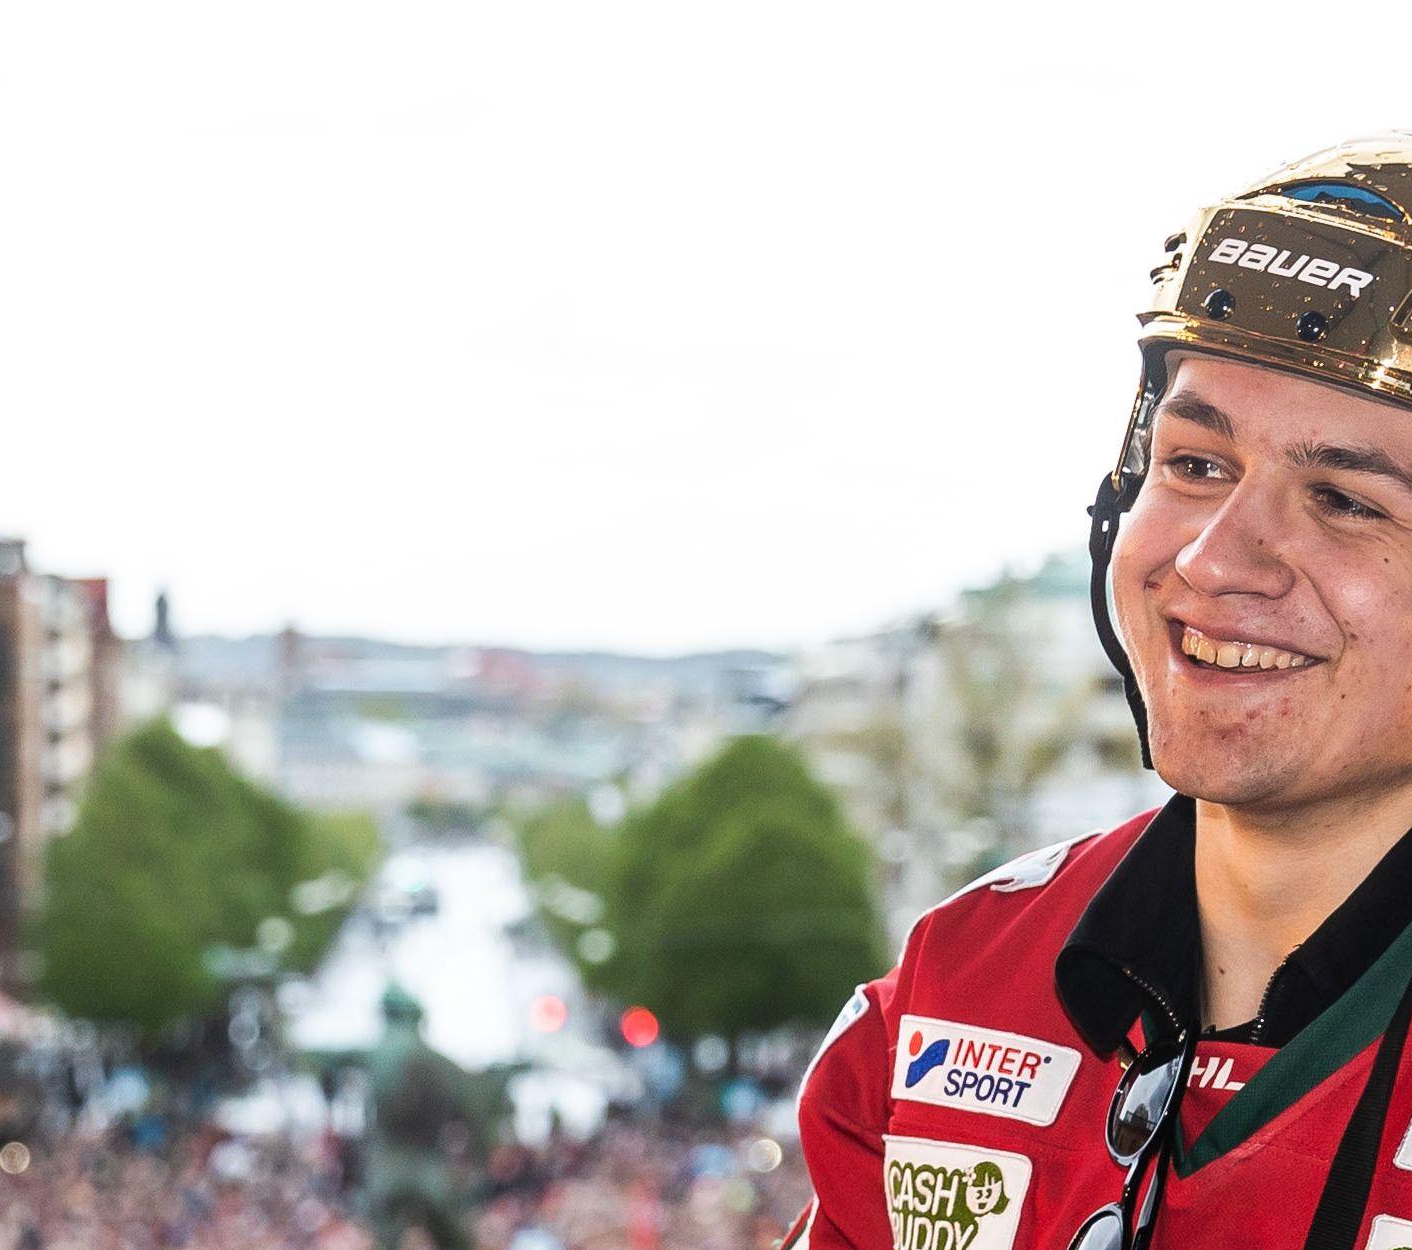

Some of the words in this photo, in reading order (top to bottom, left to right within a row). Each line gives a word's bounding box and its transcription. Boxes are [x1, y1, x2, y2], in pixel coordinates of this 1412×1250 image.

[1207, 238, 1374, 298] BAUER
[953, 1038, 1041, 1080] INTER
[1187, 1056, 1246, 1091] HL
[943, 1069, 1031, 1109] SPORT
[890, 1165, 961, 1217] CASH
